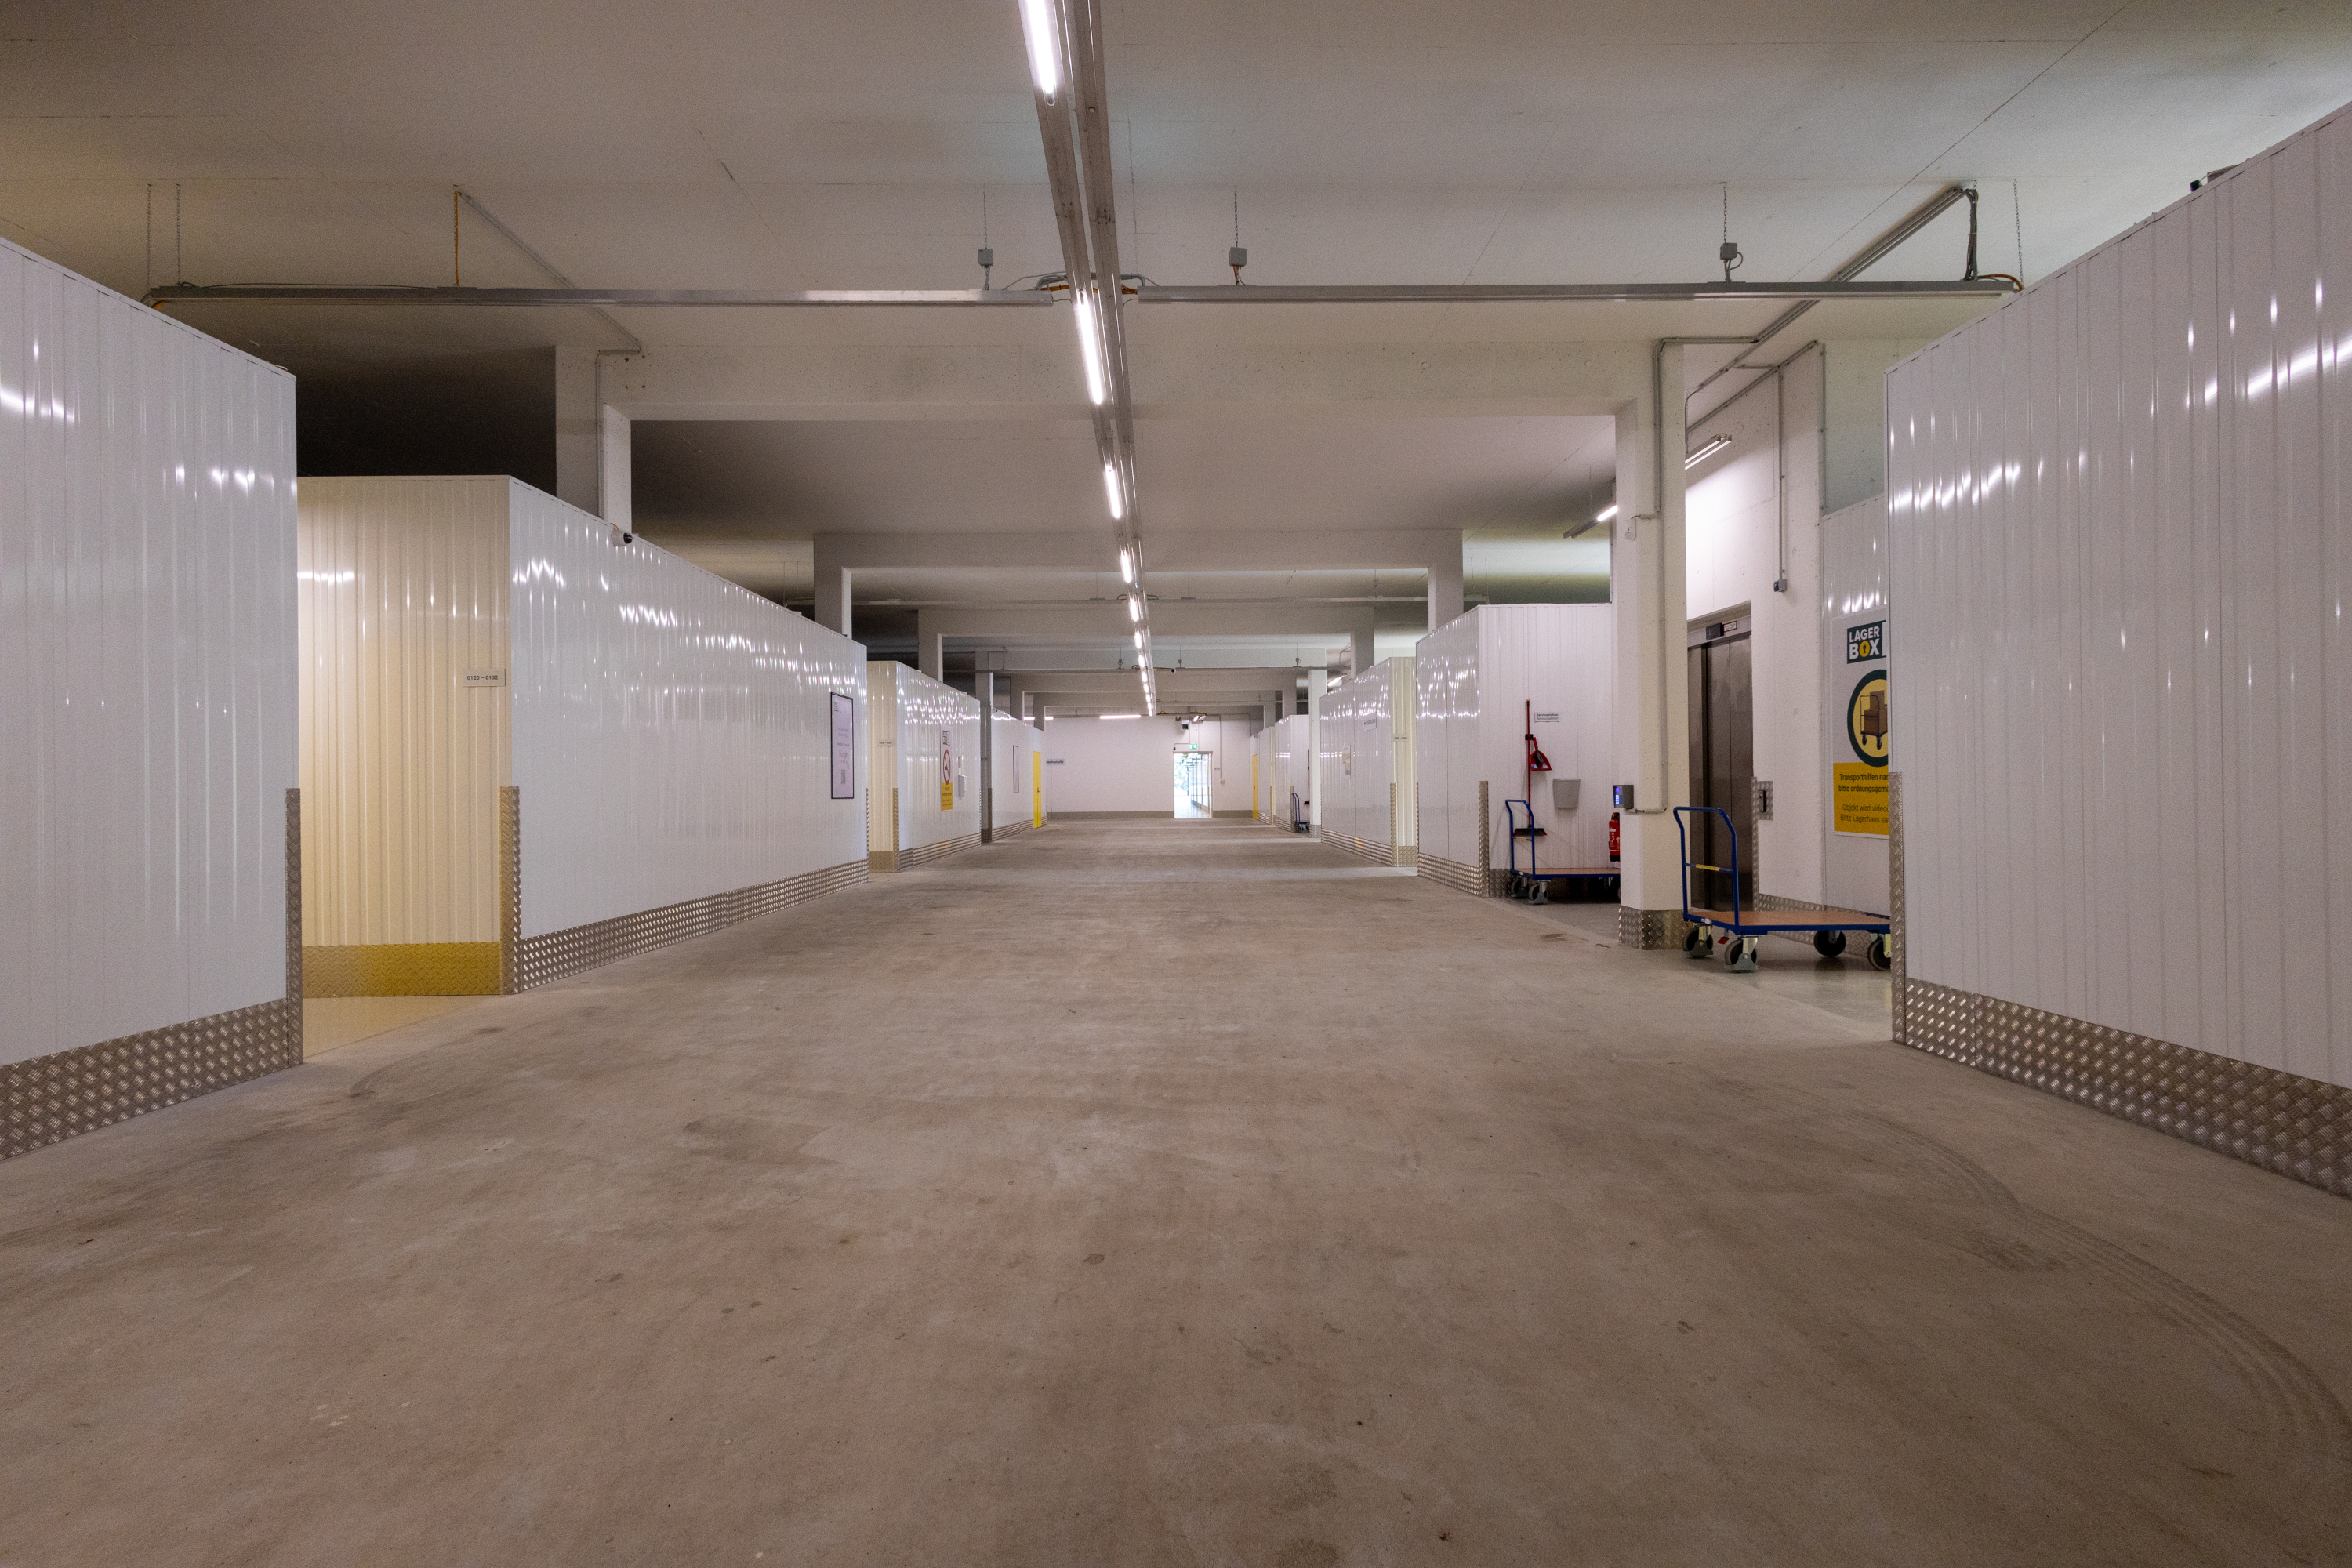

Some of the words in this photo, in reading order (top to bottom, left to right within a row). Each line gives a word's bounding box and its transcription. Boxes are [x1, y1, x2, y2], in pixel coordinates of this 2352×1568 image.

[1849, 626, 1880, 643] LAGER
[1849, 637, 1880, 660] BOX
[1839, 773, 1878, 782] Transporthilfen
[1842, 804, 1858, 812] Objekt
[1853, 815, 1880, 824] Lagerhaus
